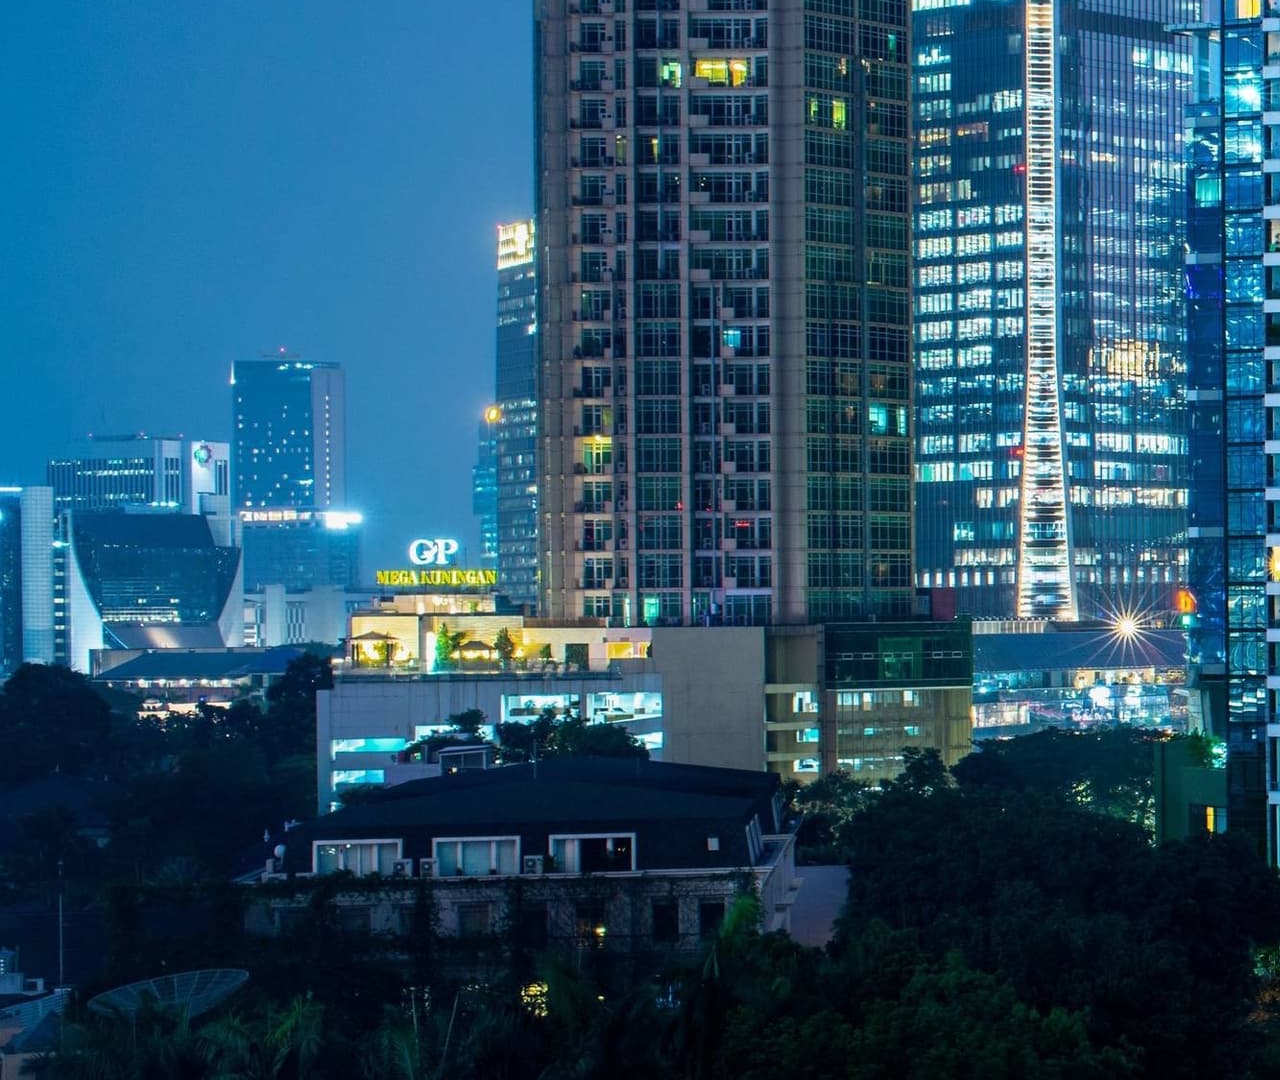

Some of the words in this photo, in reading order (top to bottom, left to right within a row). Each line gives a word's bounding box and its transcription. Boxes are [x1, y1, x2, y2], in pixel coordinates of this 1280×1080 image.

[410, 539, 458, 565] GP
[376, 570, 417, 585] MEGA
[420, 570, 497, 585] KUNINGAN
